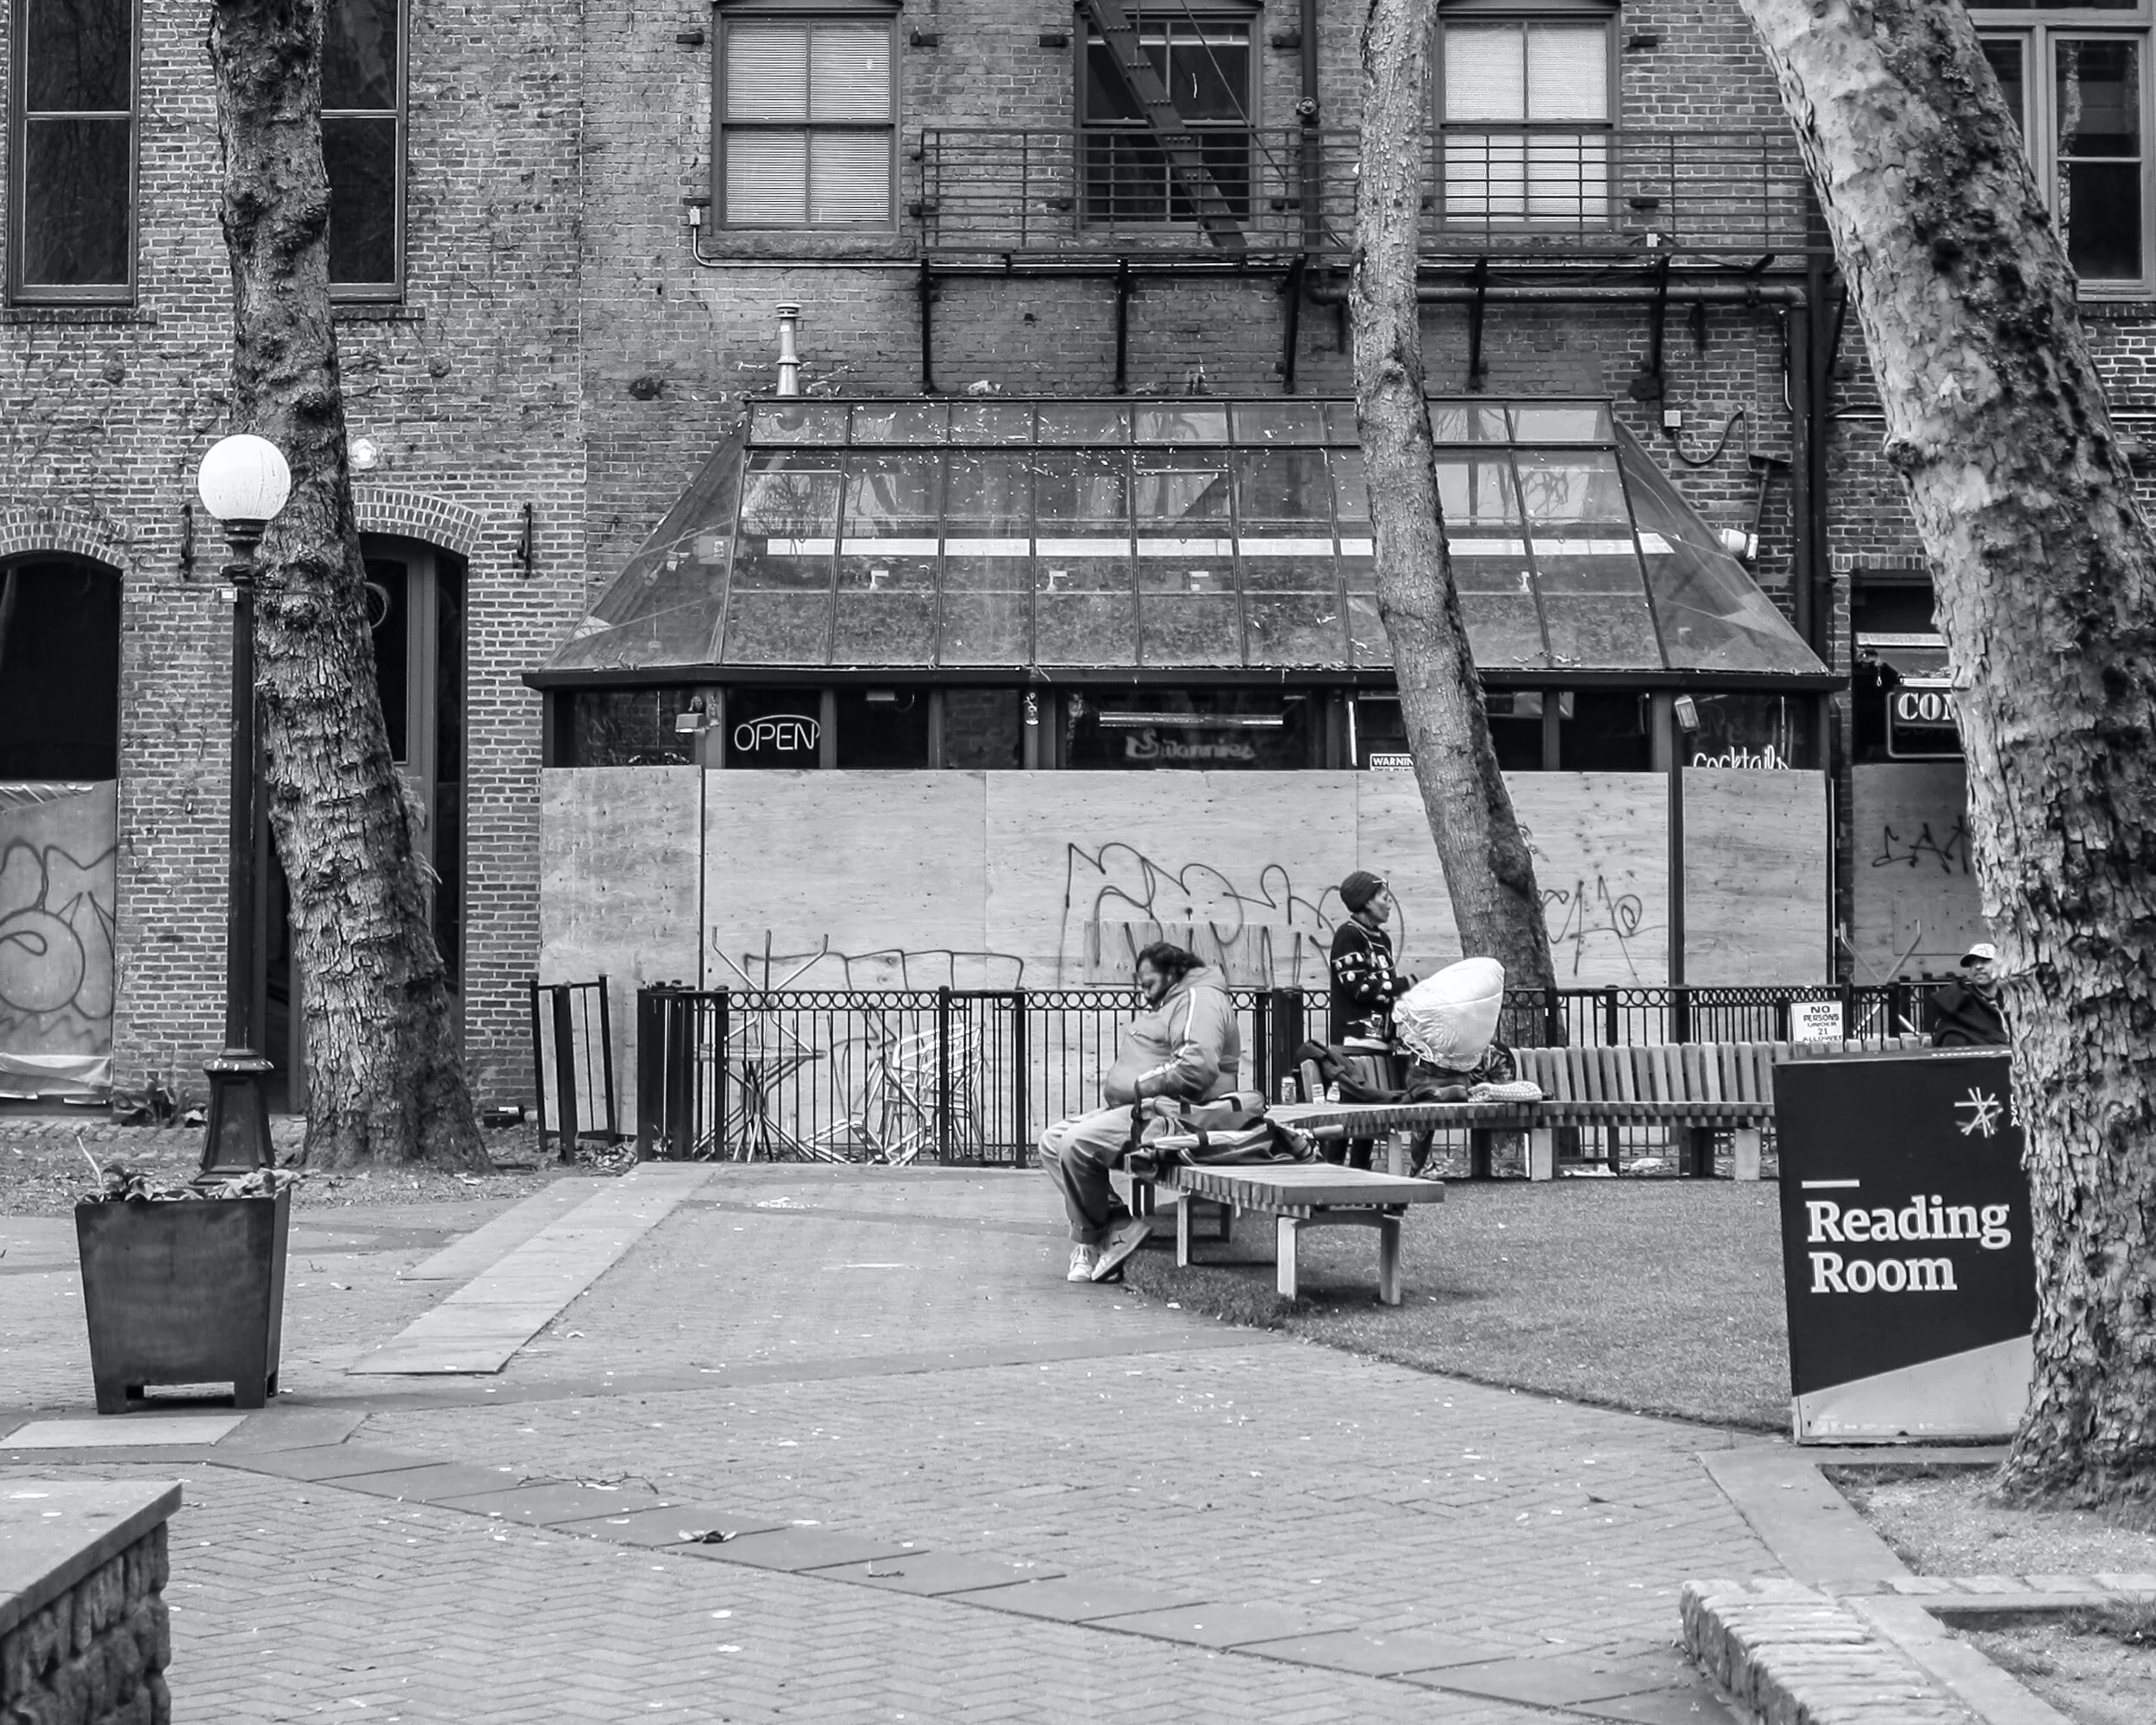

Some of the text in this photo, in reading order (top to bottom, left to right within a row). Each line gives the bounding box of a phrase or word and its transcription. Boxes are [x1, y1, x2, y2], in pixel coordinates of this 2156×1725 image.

[734, 722, 816, 751] OPEN
[1373, 756, 1414, 766] WARNIN
[1810, 1005, 1830, 1013] NO
[1805, 1195, 2012, 1249] Reading
[1808, 1251, 1958, 1293] Room
